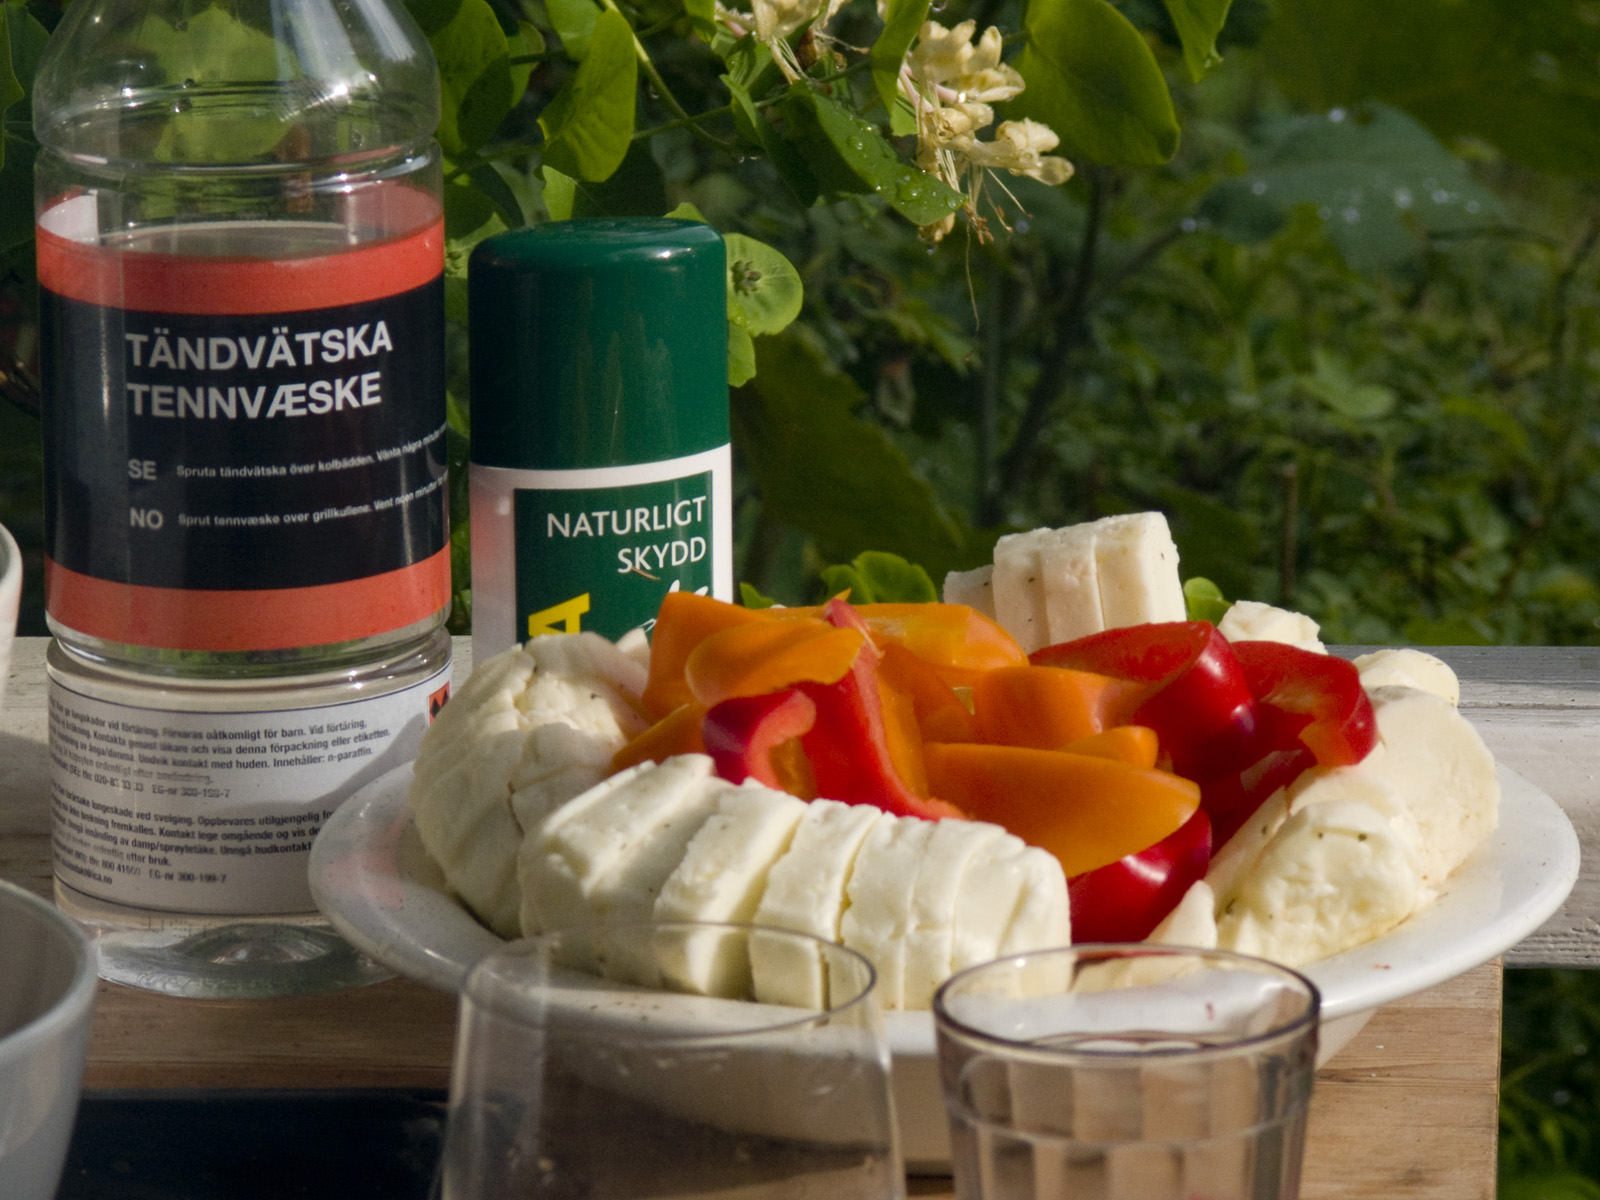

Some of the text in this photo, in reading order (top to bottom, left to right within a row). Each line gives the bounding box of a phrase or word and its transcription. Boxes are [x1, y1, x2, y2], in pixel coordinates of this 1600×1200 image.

[125, 320, 393, 370] TÄNDVÄTSKA
[126, 371, 382, 419] TENNVÆSKE
[128, 458, 157, 480] SE
[176, 464, 217, 478] Spruta
[219, 464, 286, 477] tändvätska
[289, 462, 315, 475] över
[130, 508, 163, 530] NO
[178, 512, 211, 527] Sprut
[283, 512, 310, 524] over
[547, 496, 706, 538] NATURLIGT
[617, 536, 706, 573] SKYDD
[107, 717, 119, 730] vid
[206, 727, 261, 741] oåtkomligt
[264, 727, 278, 739] för
[281, 727, 306, 738] barn.
[309, 724, 324, 734] Vid
[93, 730, 126, 747] Kontakta
[191, 744, 208, 754] och
[211, 744, 232, 755] visa
[235, 743, 266, 755] denna
[270, 738, 328, 753] förpackning
[331, 735, 351, 747] eller
[211, 758, 232, 769] med
[235, 756, 270, 769] huden.
[136, 810, 151, 821] ved
[197, 815, 255, 827] Oppbevares
[258, 810, 319, 826] utilgjengelig
[276, 829, 289, 840] og
[291, 826, 306, 838] vis
[149, 855, 172, 867] bruk.
